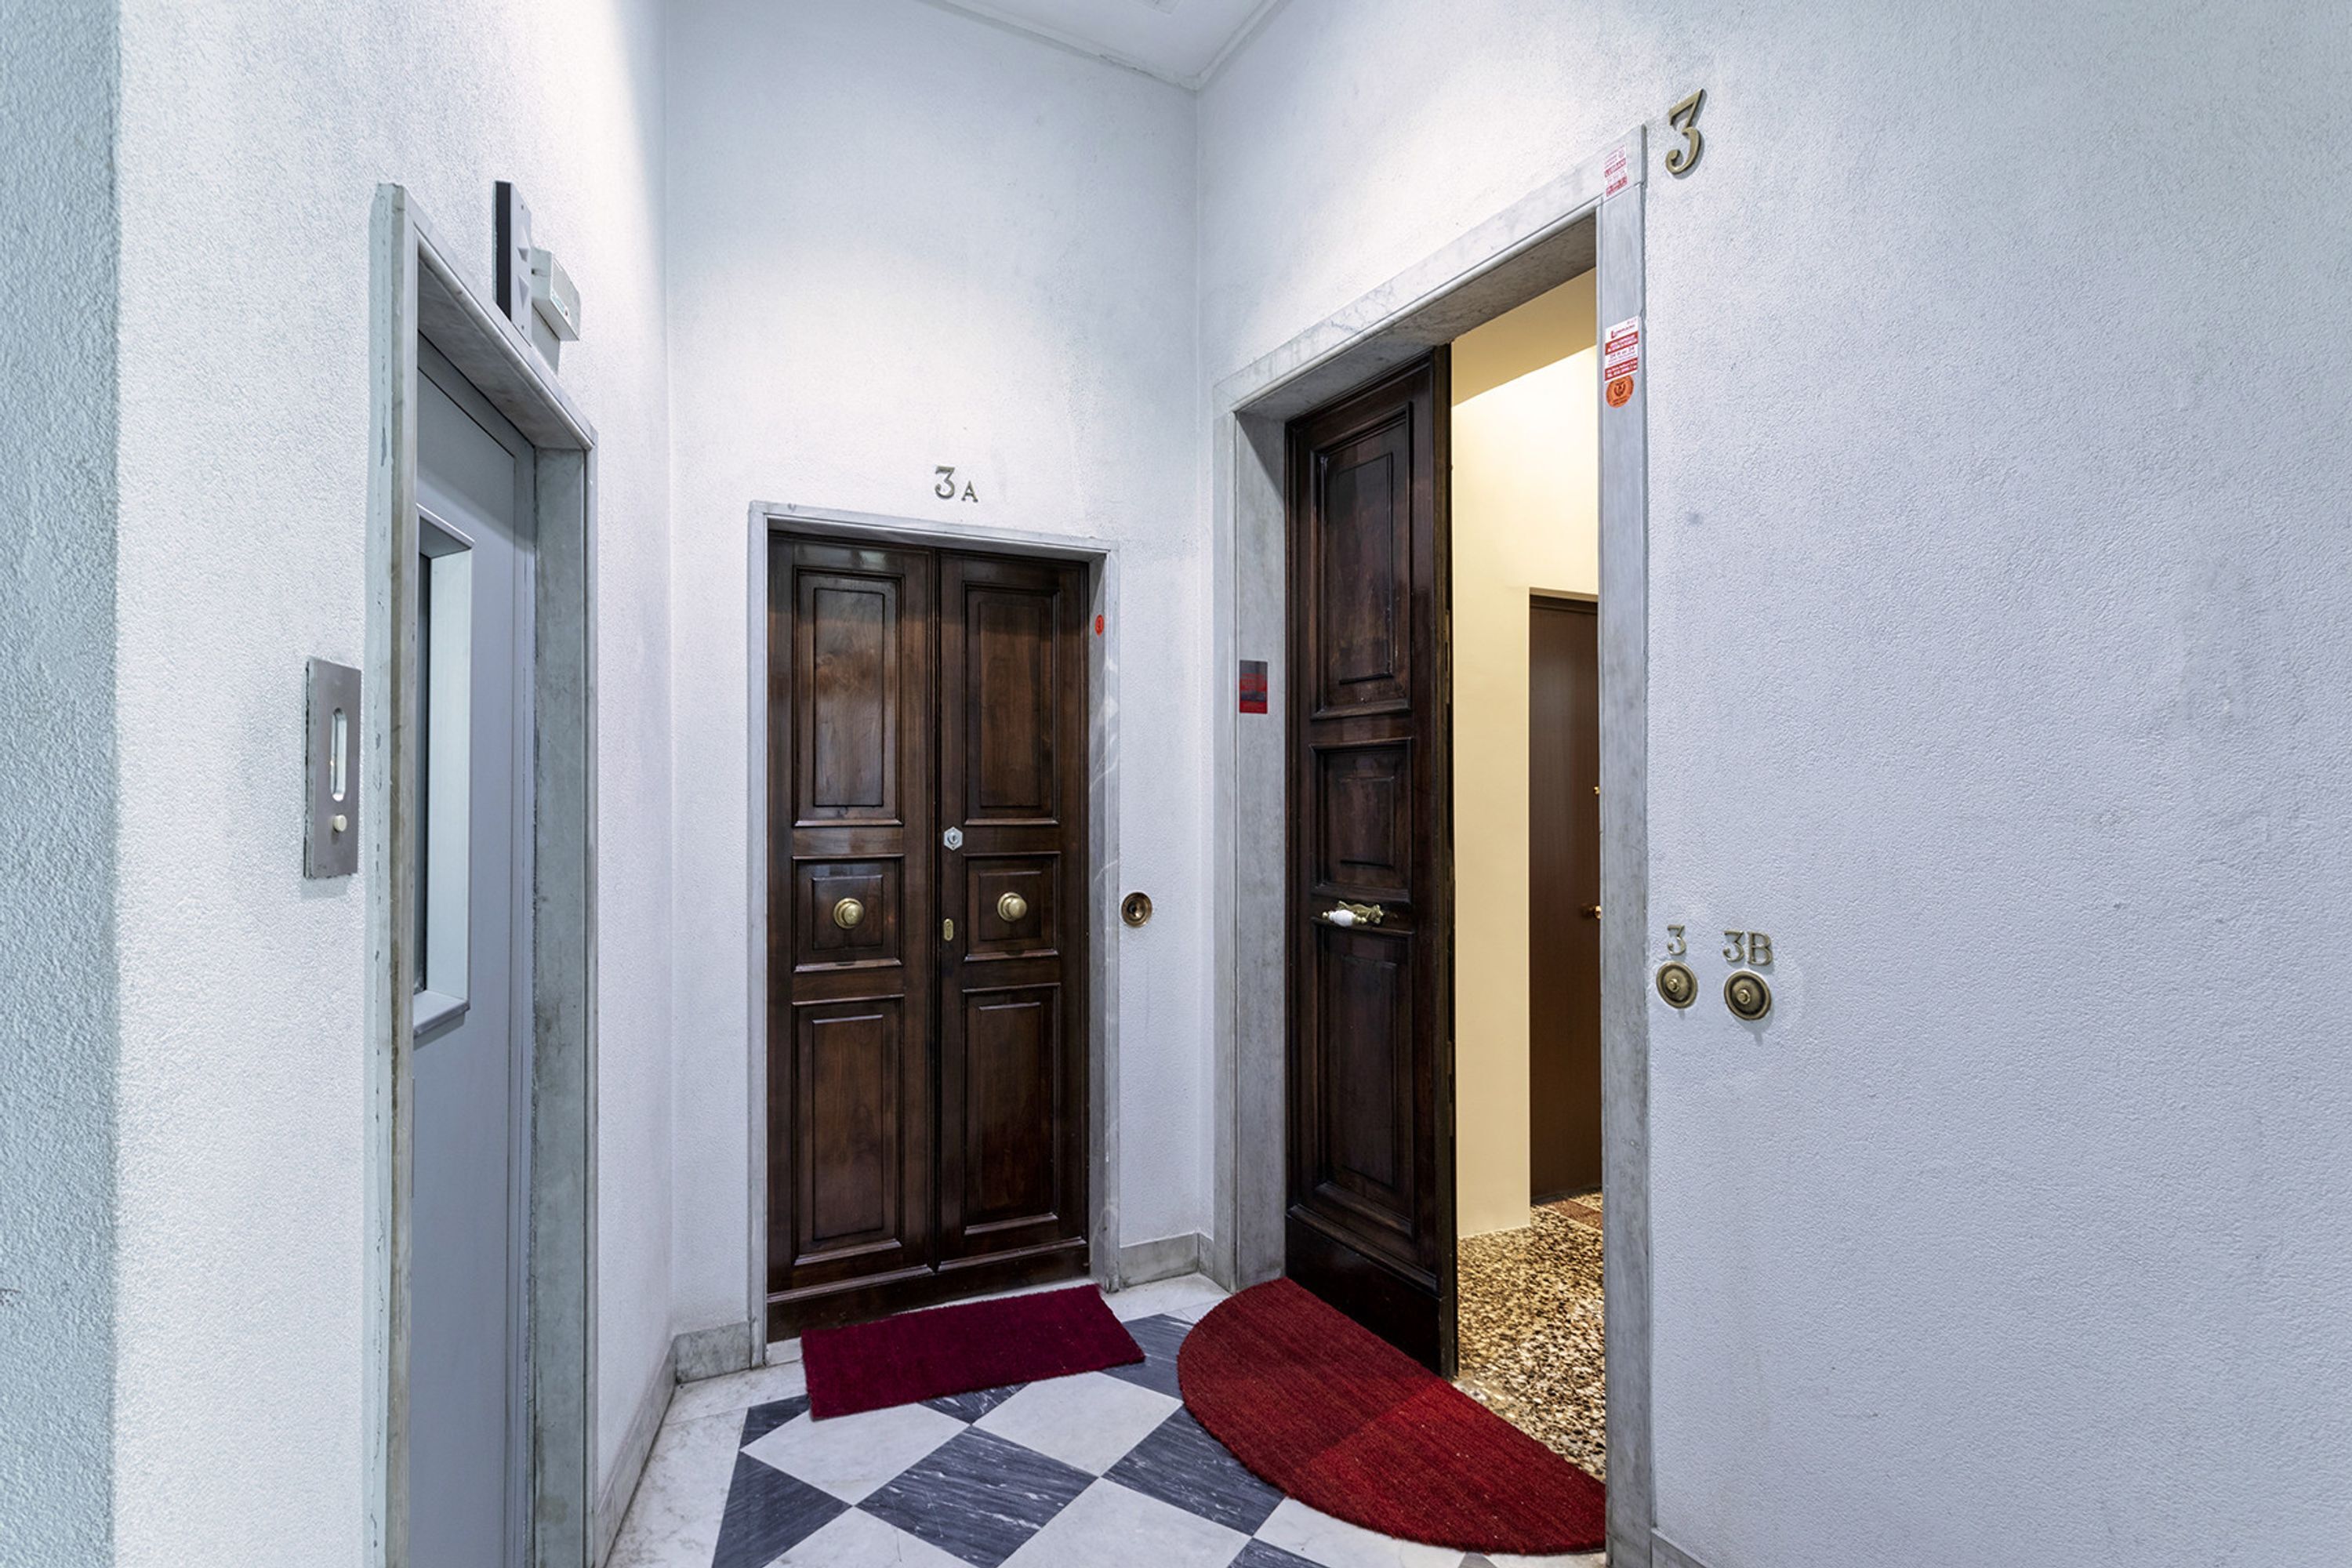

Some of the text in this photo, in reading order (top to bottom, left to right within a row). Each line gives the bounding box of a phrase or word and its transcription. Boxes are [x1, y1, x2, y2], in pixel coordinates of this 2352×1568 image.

[1665, 87, 1704, 175] 3
[1667, 924, 1686, 956] 3
[1722, 930, 1773, 966] 3B
